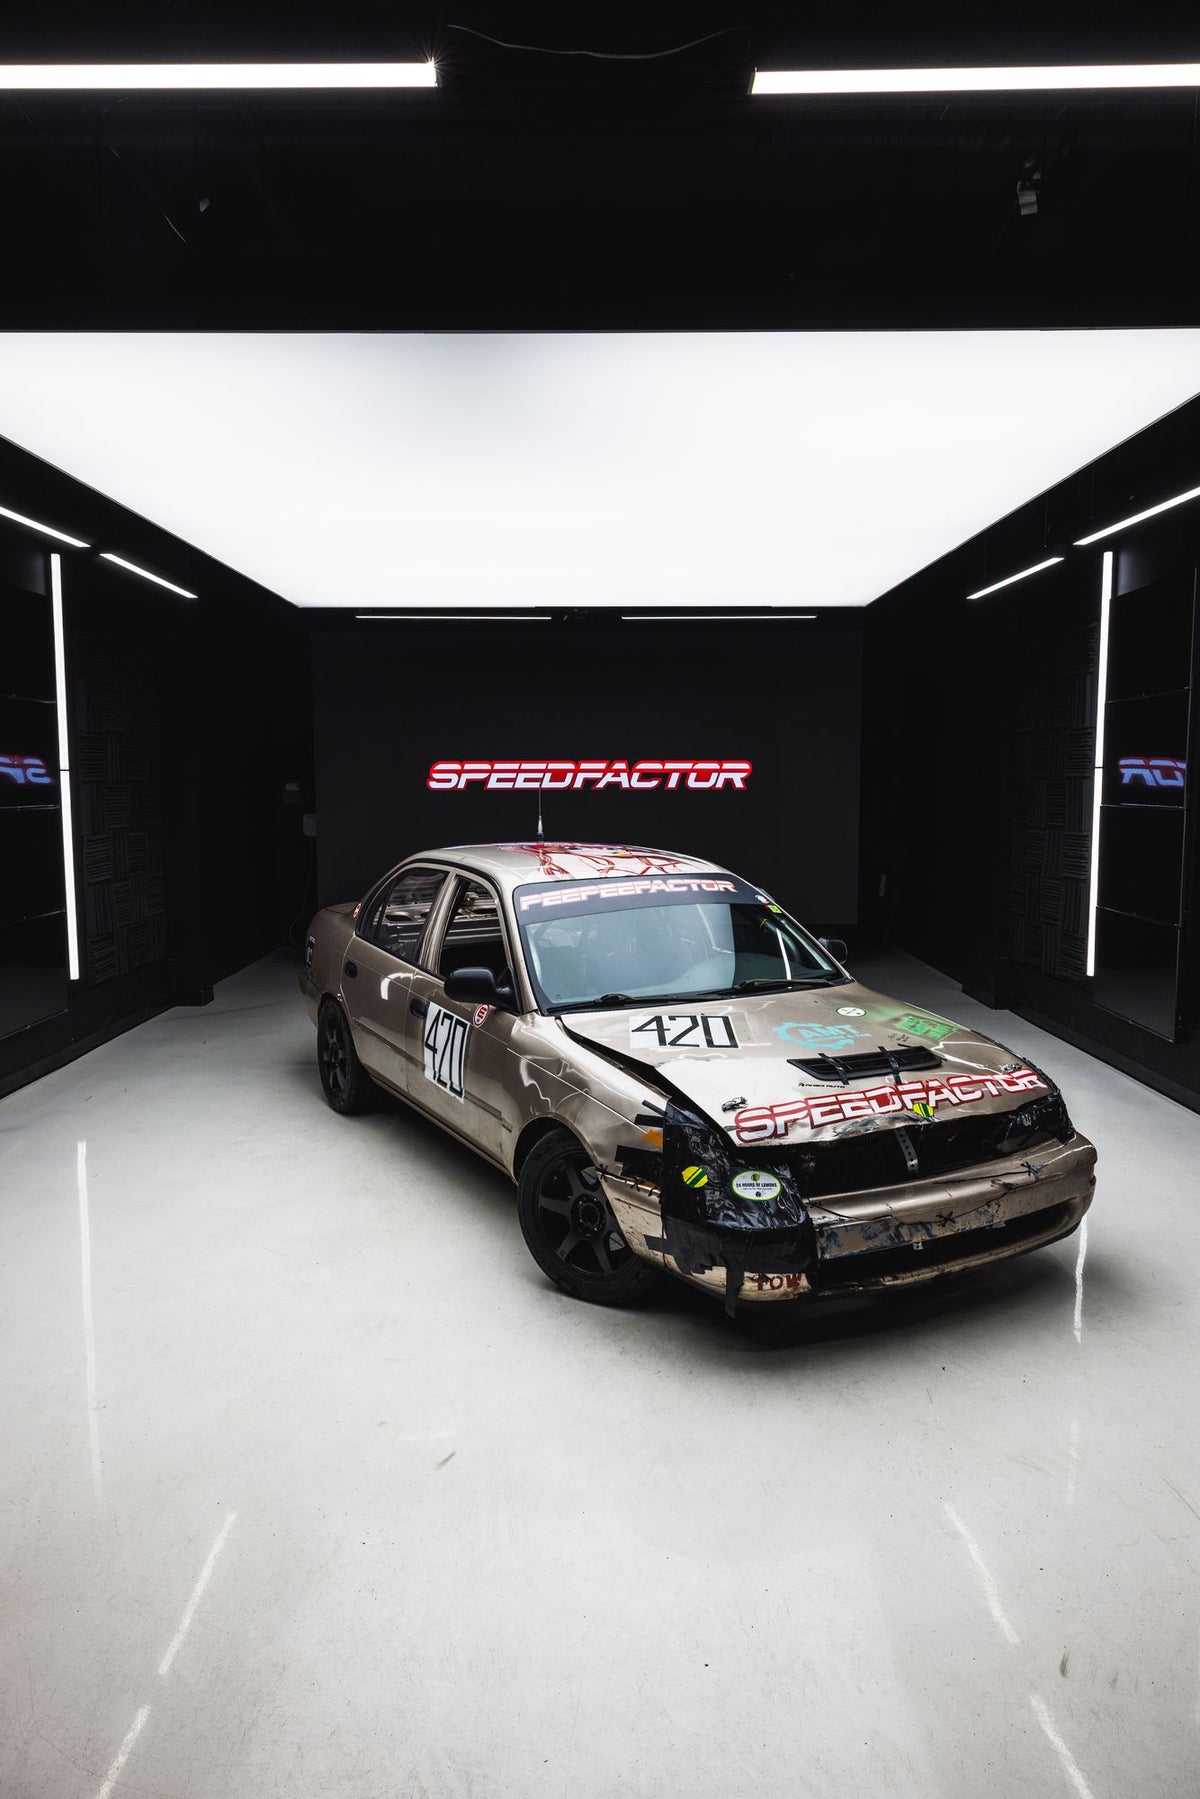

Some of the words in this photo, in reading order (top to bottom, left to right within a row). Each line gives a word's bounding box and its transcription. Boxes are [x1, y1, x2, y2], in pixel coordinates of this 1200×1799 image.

[427, 760, 752, 790] SPEEDFACTOR
[519, 879, 738, 911] PEEPEEFACTOR
[631, 1015, 739, 1049] 420
[425, 1009, 469, 1098] 420
[735, 1068, 1047, 1143] SPEEDFACTOR
